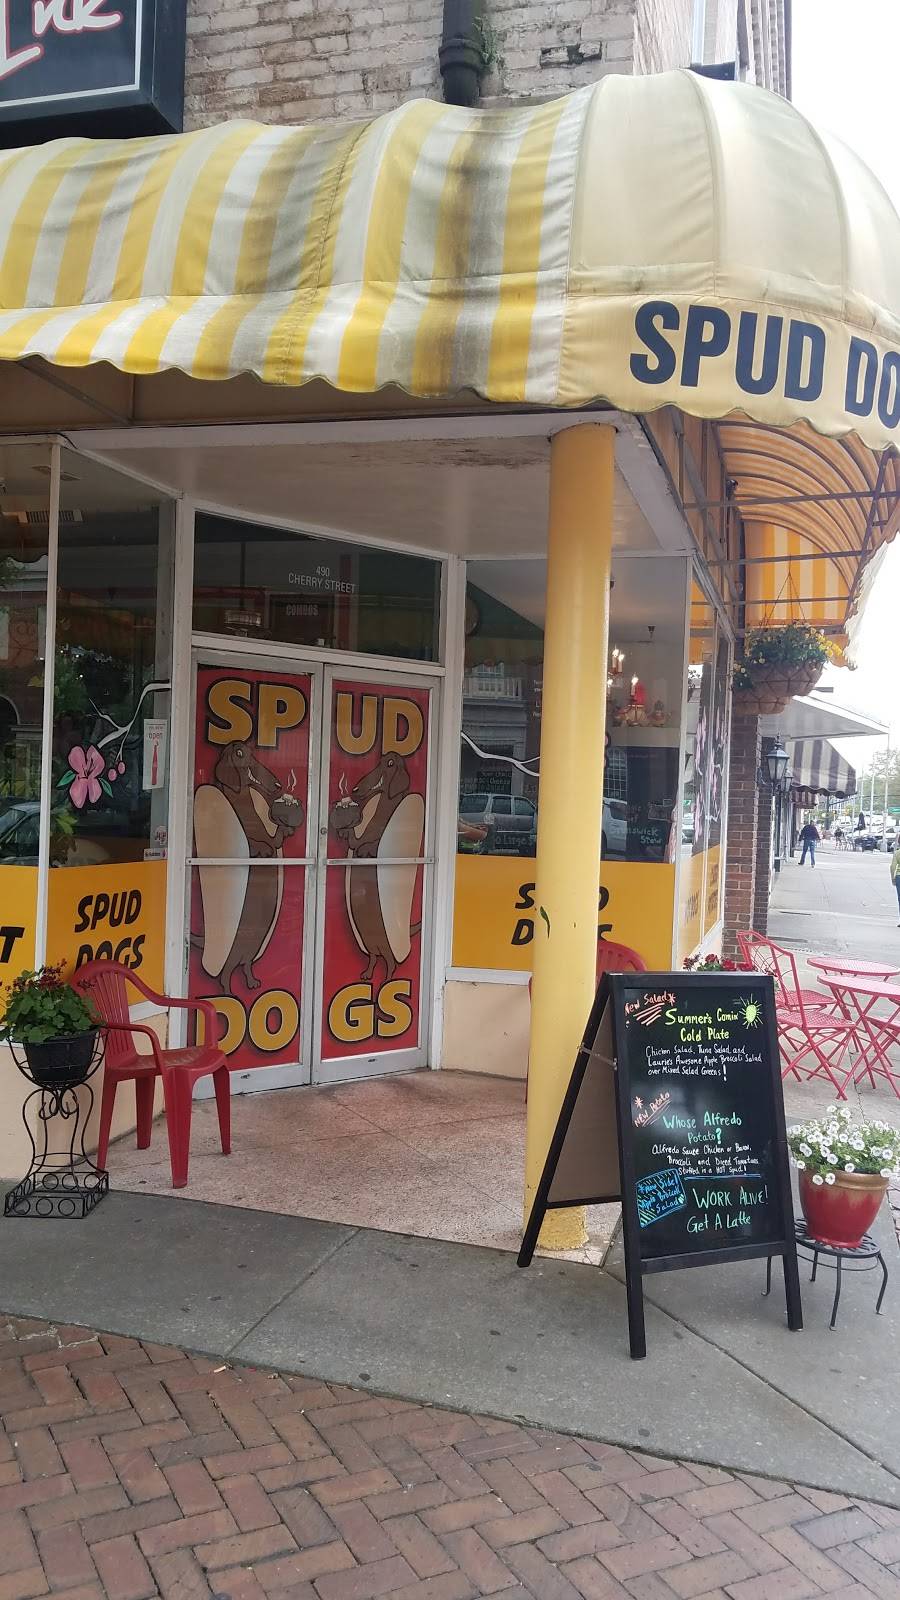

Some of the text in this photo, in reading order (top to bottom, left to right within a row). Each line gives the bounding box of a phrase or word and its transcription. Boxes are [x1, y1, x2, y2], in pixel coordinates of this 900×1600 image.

[630, 301, 826, 401] SPUD
[316, 566, 330, 577] 490
[288, 572, 356, 594] CHERRY STREET
[74, 889, 142, 933] SPUD
[680, 1026, 730, 1042] Cold Plate
[645, 1045, 671, 1058] Chicken
[697, 1044, 712, 1054] Tuna
[732, 1045, 746, 1055] and
[675, 1054, 702, 1065] Awesome
[719, 1054, 743, 1065] Broccoli
[744, 1052, 763, 1063] Salad
[647, 1068, 661, 1076] over
[661, 1065, 680, 1075] Mixed
[681, 1065, 699, 1076] Salad
[662, 1111, 743, 1130] Whose Alfredo
[687, 1127, 722, 1145] Potato?
[692, 1188, 733, 1210] WORK
[686, 1211, 751, 1233] Get A Latte
